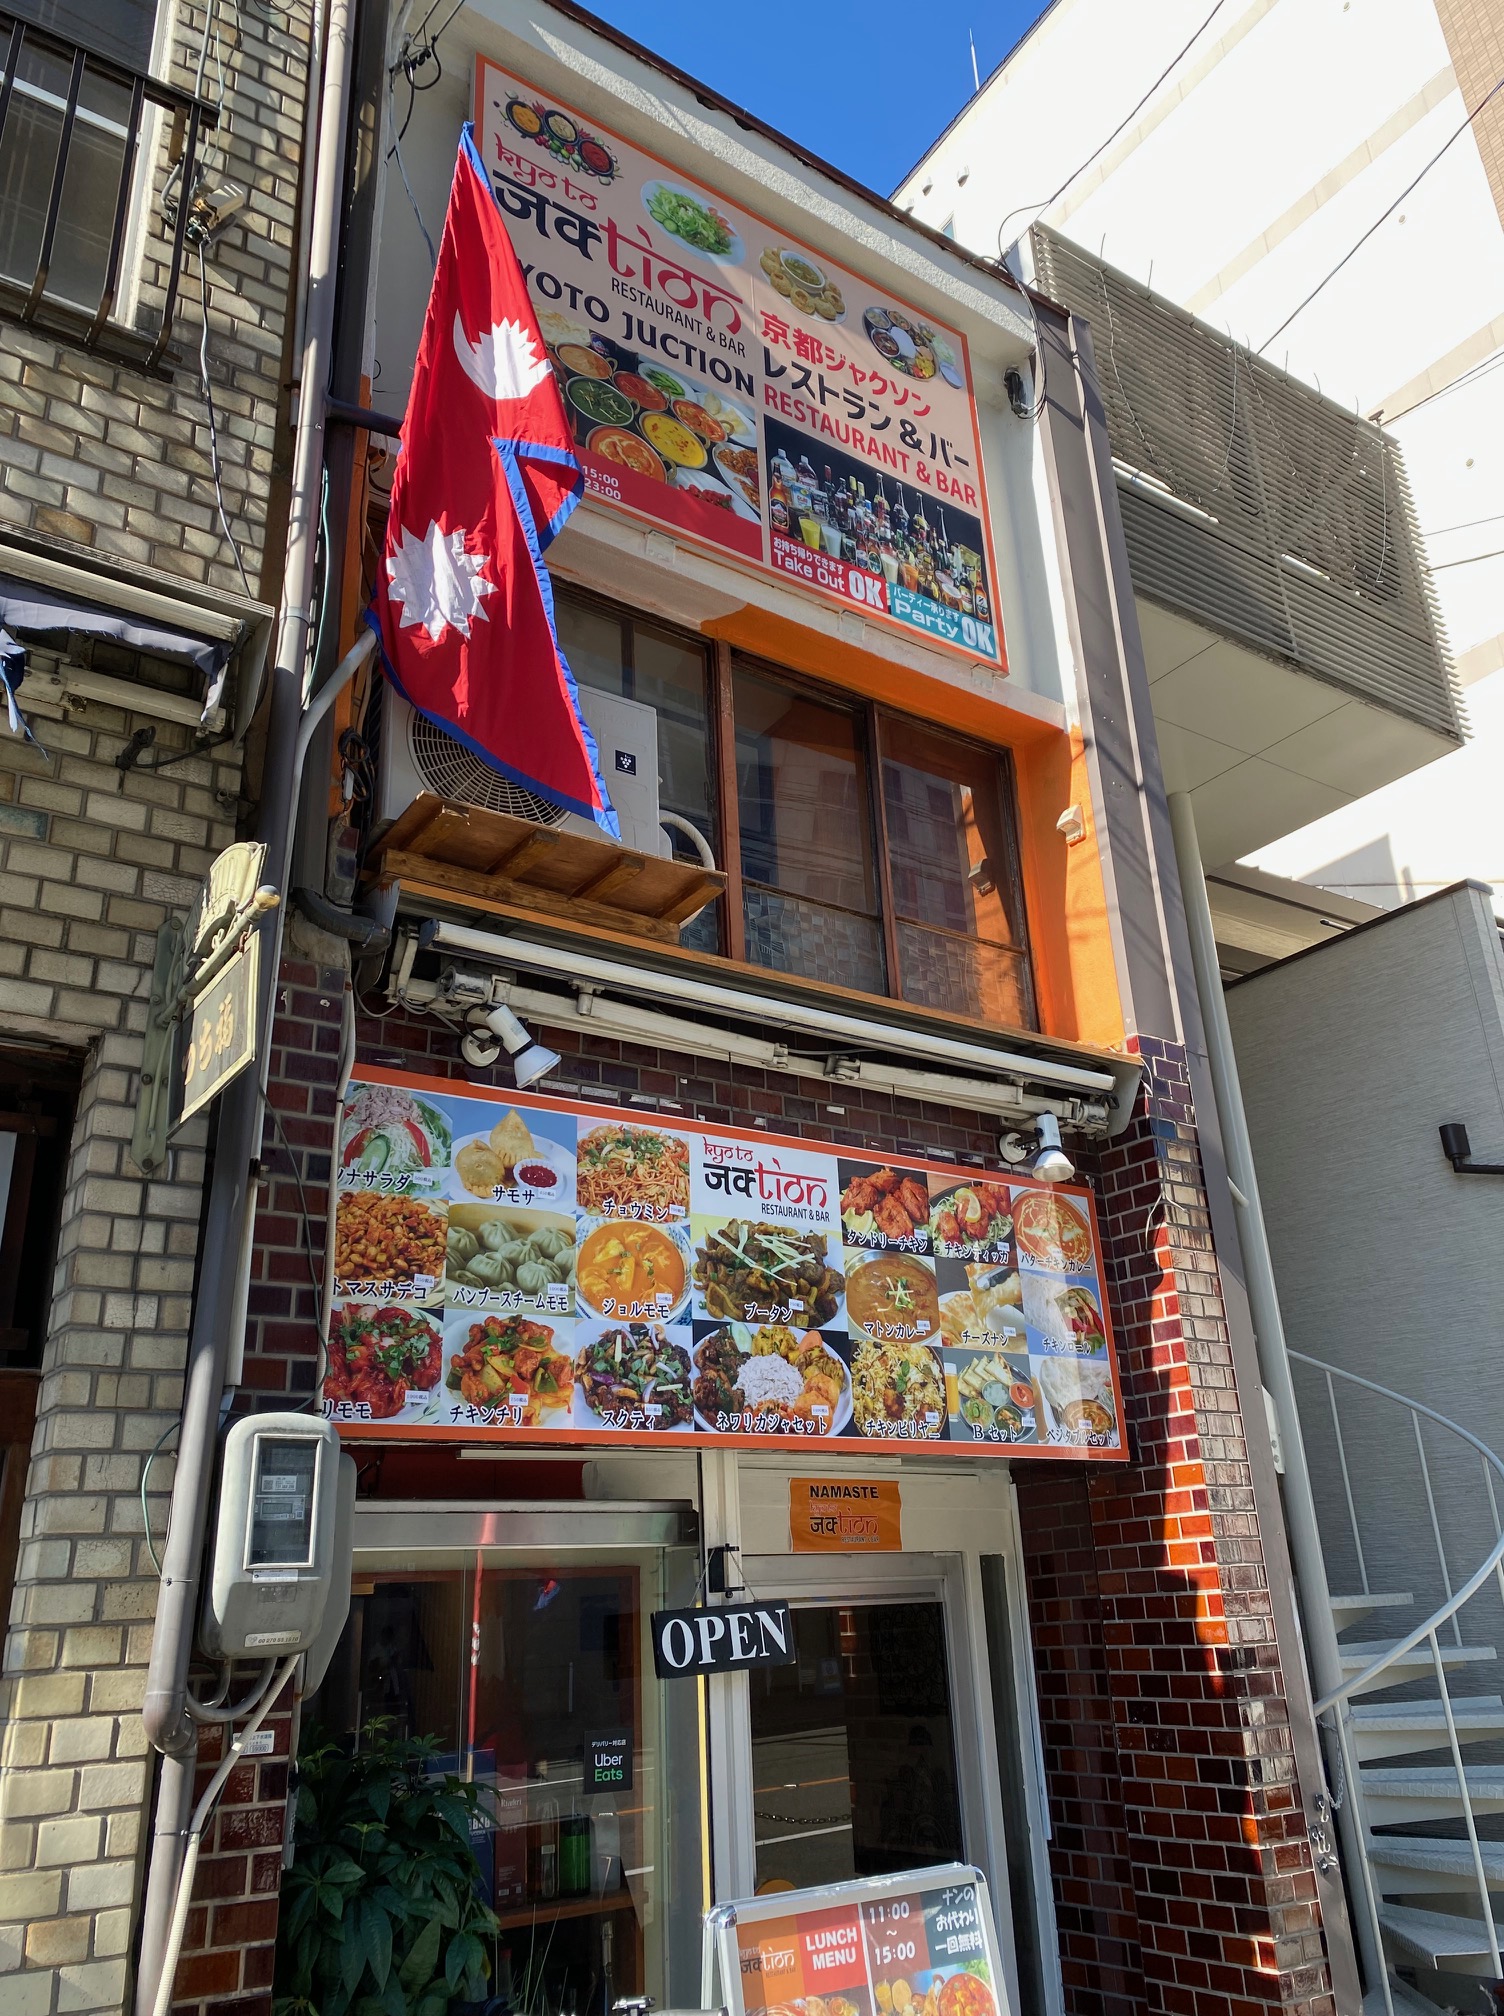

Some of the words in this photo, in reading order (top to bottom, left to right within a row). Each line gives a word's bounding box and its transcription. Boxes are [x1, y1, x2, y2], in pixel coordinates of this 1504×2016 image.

[517, 258, 611, 324] YOTO
[621, 310, 756, 398] JUCTION
[611, 277, 703, 335] RESTAURANT
[706, 326, 716, 341] &
[719, 332, 746, 358] BAR
[760, 309, 931, 417] 京都ジャクソン
[764, 384, 910, 474] RESTAURANT
[916, 461, 932, 487] &
[936, 469, 978, 508] BAR
[582, 465, 619, 487] 15:00
[584, 477, 622, 500] 23:00
[773, 536, 844, 575] お持ち帰りできます
[773, 549, 813, 578] Take
[817, 567, 846, 593] Out
[849, 570, 884, 610] OK
[894, 600, 960, 638] Party
[961, 616, 994, 654] OK
[492, 1185, 535, 1206] サモサ
[602, 1198, 669, 1221] チョウミン
[761, 1202, 808, 1220] RESTAURANT
[808, 1210, 814, 1221] &
[815, 1211, 830, 1222] BAR
[847, 1229, 928, 1253] タンドリーチキン
[944, 1241, 1009, 1265] チキンティッカ
[453, 1287, 569, 1312] バンブースチームモモ
[601, 1298, 670, 1319] ジョルモモ
[745, 1302, 793, 1323] ブータン
[864, 1321, 926, 1340] マトンカレー
[962, 1329, 1009, 1347] チーズナン
[450, 1404, 523, 1426] チキンチリ
[602, 1410, 656, 1430] スクティ
[717, 1411, 827, 1434] ネワリカジャセット
[865, 1418, 940, 1439] チキンビリヤニ
[810, 1485, 879, 1498] NAMASTE
[660, 1608, 787, 1669] OPEN
[591, 1739, 627, 1748] デリバリー対応店
[594, 1753, 624, 1767] Uber
[594, 1768, 624, 1782] Eats
[942, 1886, 975, 1906] ナンの
[869, 1901, 911, 1925] 11:00
[935, 1908, 979, 1932] お代わり
[805, 1926, 858, 1951] LUNCH
[935, 1930, 983, 1955] 一回無料
[812, 1947, 857, 1971] MENU
[874, 1941, 916, 1966] 15:00
